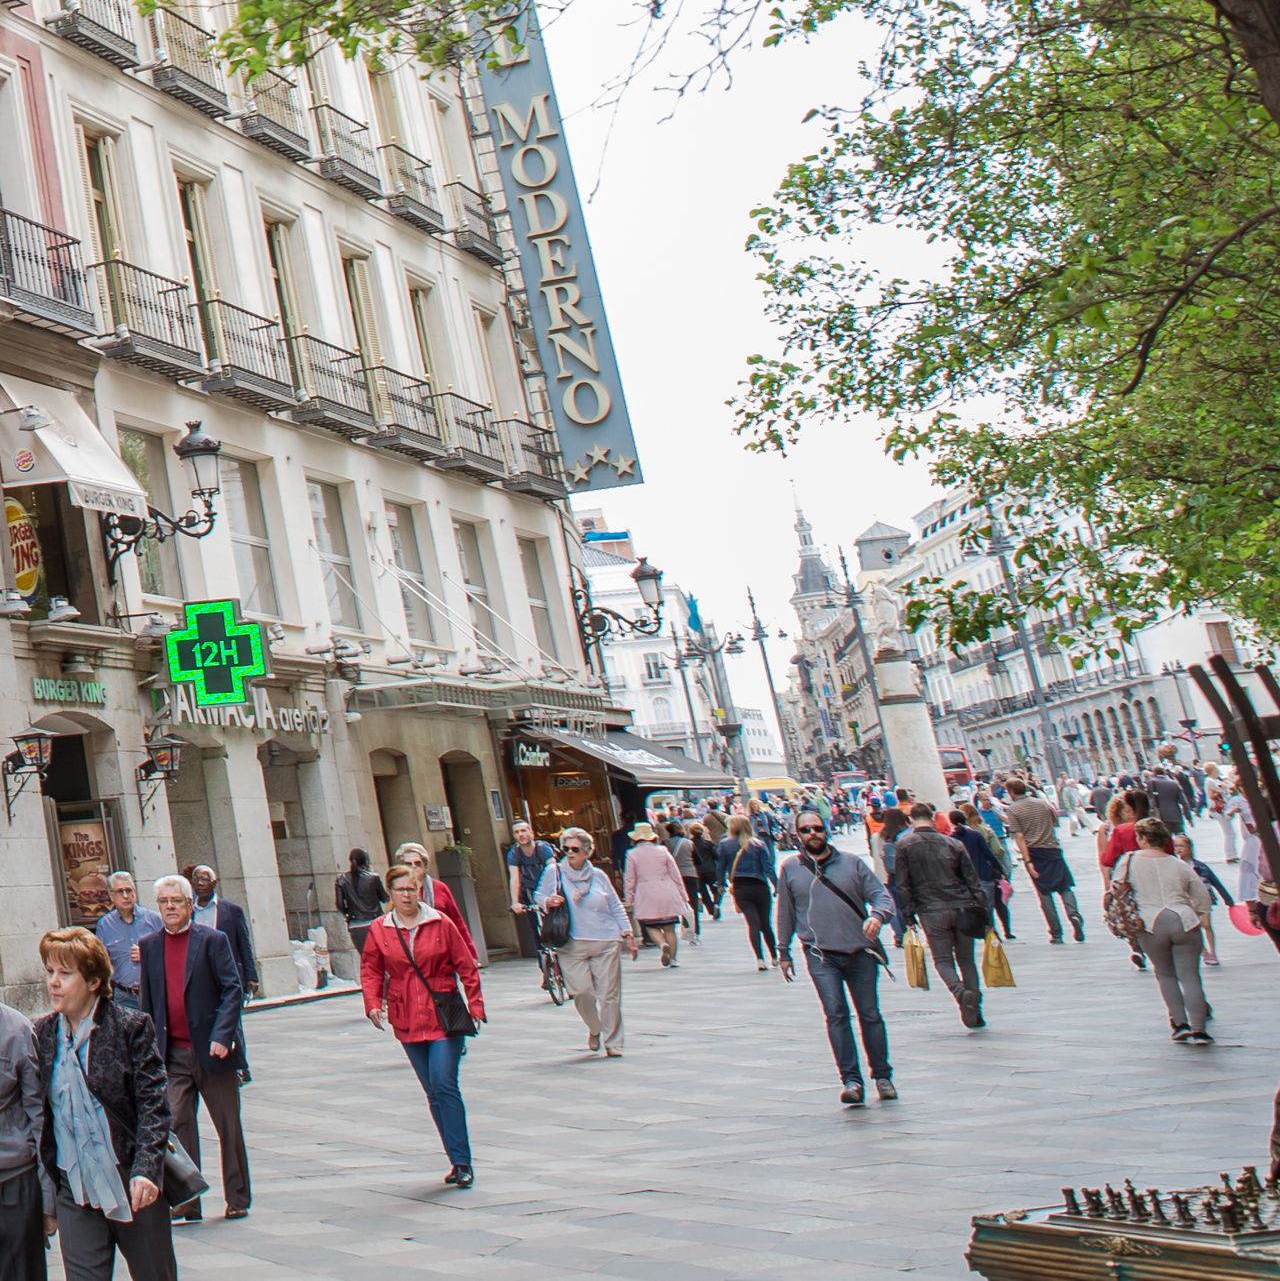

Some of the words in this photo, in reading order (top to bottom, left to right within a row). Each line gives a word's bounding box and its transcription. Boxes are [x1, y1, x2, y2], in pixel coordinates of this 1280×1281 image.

[491, 93, 612, 426] MODERNO
[17, 456, 34, 467] KING
[84, 489, 115, 508] BURGER
[116, 495, 136, 512] KING
[9, 522, 34, 546] URGER
[11, 541, 39, 574] ING
[191, 639, 240, 669] 12H
[32, 678, 79, 702] BURGER
[80, 681, 108, 705] KING
[162, 684, 278, 731] ARACIA
[63, 840, 104, 859] KINGS
[73, 832, 89, 842] The
